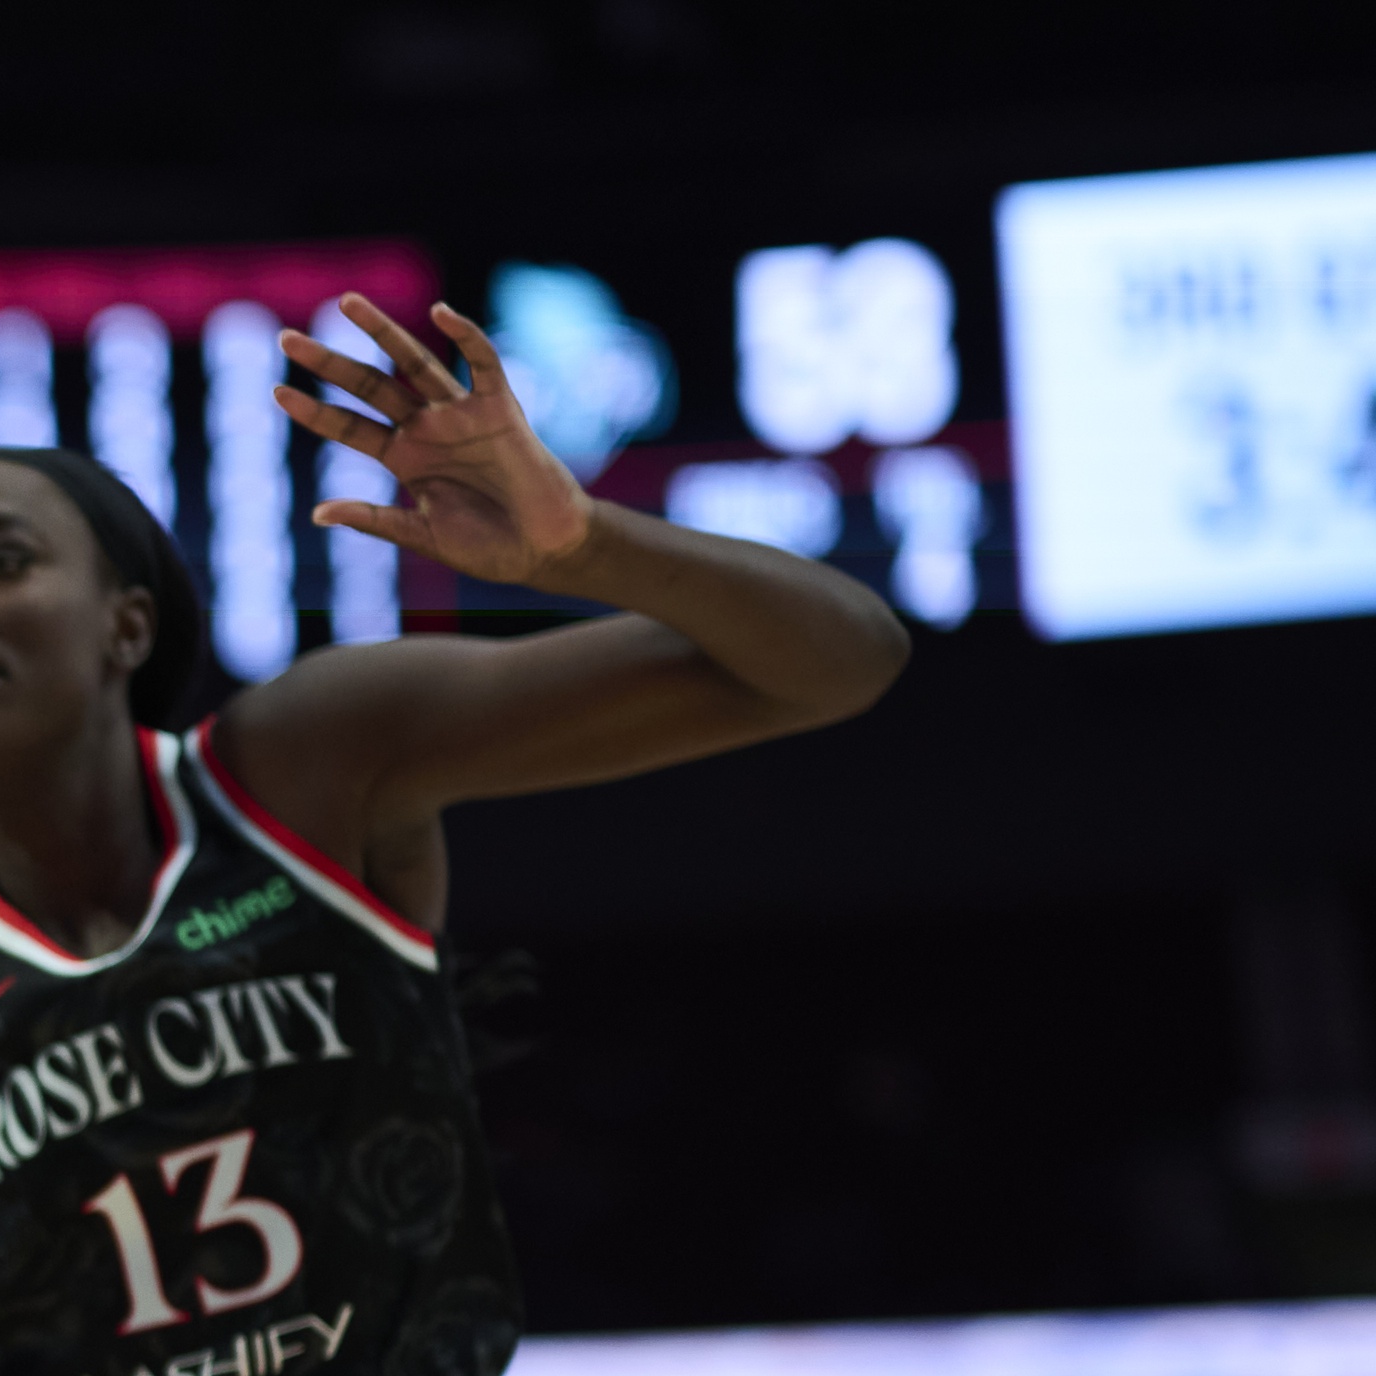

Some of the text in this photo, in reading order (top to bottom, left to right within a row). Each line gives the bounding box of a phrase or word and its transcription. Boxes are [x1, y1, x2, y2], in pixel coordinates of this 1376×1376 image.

[175, 875, 297, 951] chime
[146, 972, 353, 1089] CITY
[80, 1128, 304, 1336] 13
